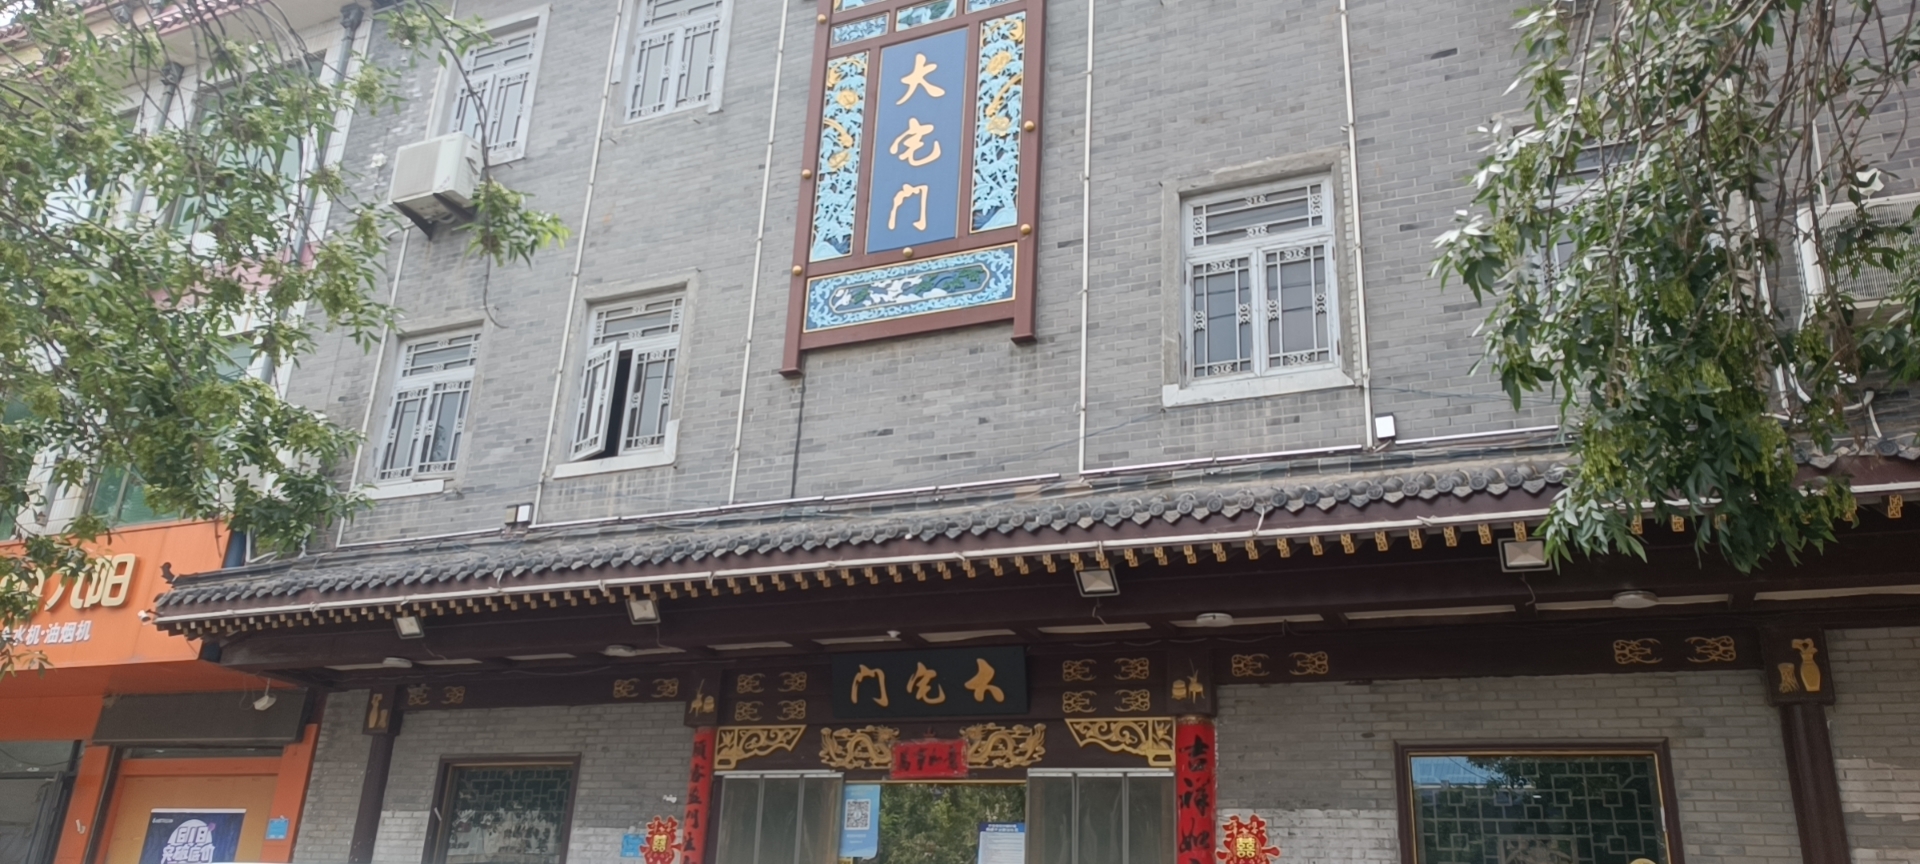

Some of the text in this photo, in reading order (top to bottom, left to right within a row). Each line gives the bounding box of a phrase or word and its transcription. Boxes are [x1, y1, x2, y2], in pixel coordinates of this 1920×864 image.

[888, 52, 946, 231] 大宅门
[175, 826, 209, 844] 618
[1178, 733, 1211, 864] 吉祥如
